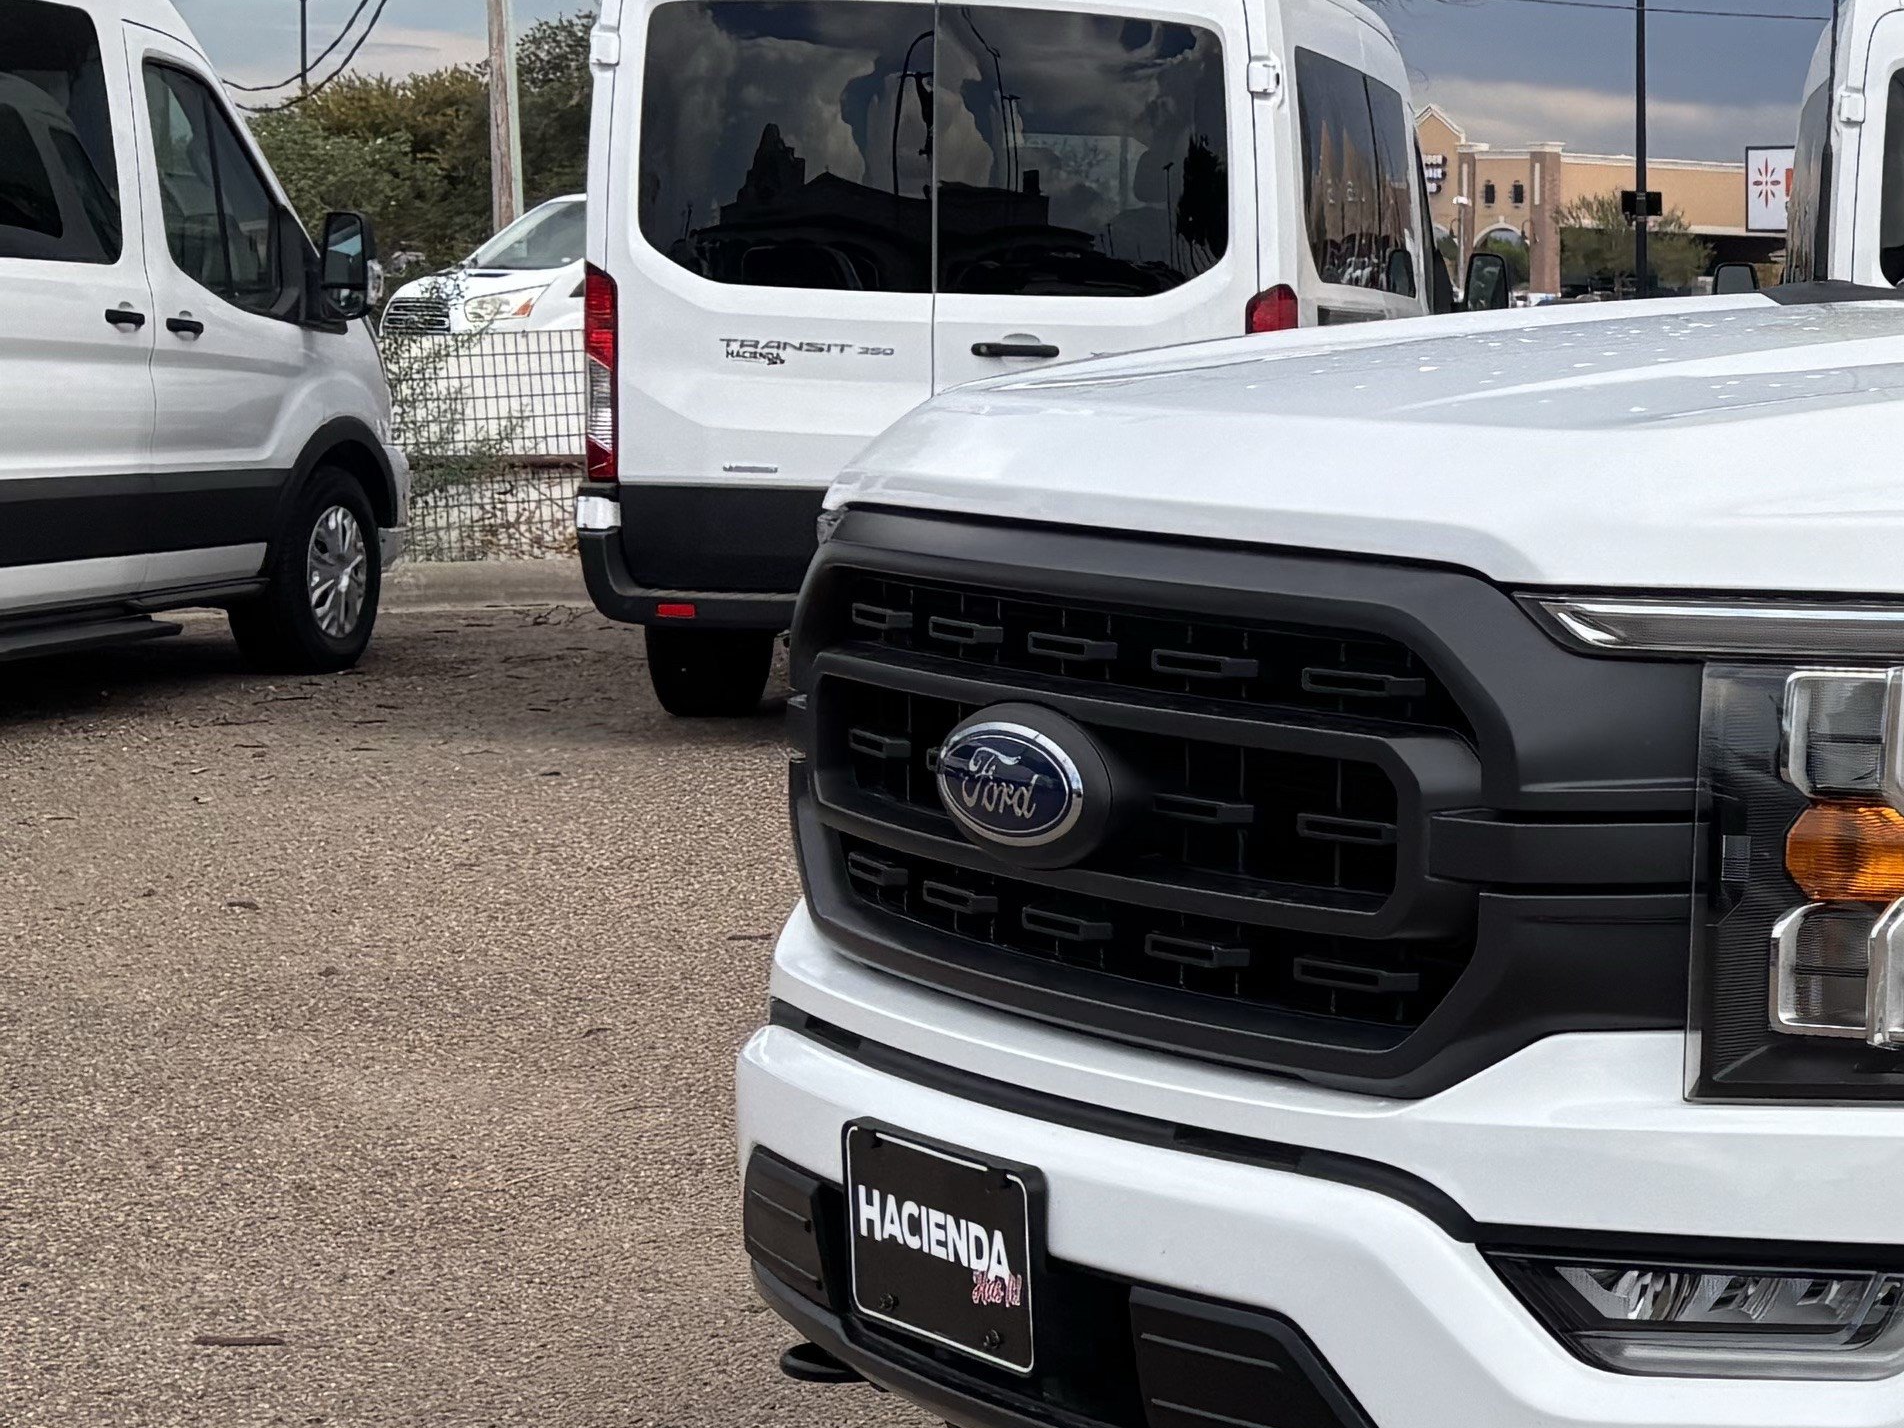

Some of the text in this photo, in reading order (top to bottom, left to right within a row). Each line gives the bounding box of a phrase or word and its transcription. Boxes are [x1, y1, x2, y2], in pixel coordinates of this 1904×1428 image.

[719, 338, 853, 353] TRANSIT
[961, 746, 1039, 820] Ford
[857, 1184, 1012, 1284] HACIENDA
